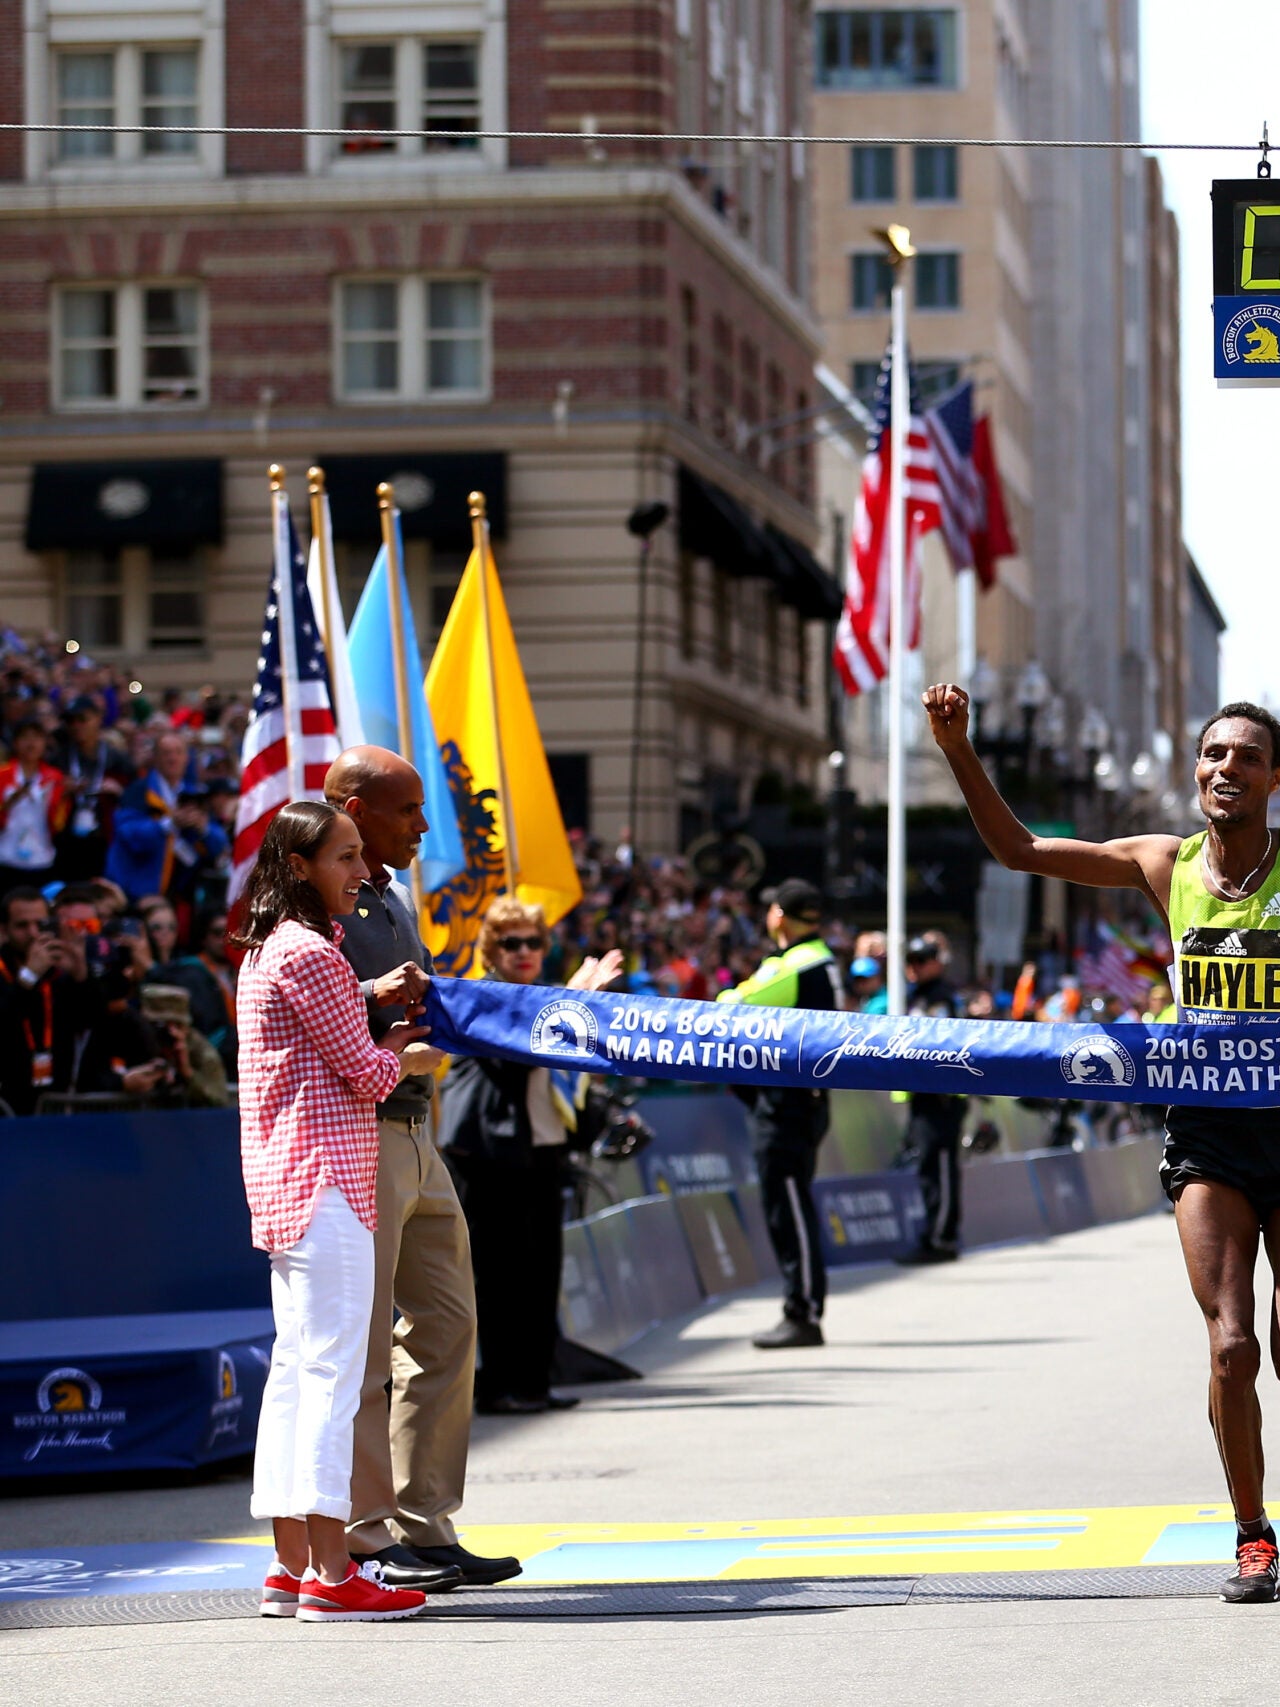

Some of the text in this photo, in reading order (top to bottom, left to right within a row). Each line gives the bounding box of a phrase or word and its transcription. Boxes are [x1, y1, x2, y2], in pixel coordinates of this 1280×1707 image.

[1225, 326, 1238, 359] BOSTON
[1233, 307, 1273, 328] ATHLETIC
[1214, 945, 1248, 956] adidas
[541, 1002, 577, 1019] ATHLETIC
[576, 1004, 597, 1054] ASSOCIATION
[609, 1006, 786, 1041] 2016 BOSTON
[1211, 1012, 1236, 1021] BOSTON
[605, 1035, 782, 1071] MARATHON
[1063, 1037, 1134, 1082] BOSTON ATHLETIC ASSOCIATION
[1145, 1037, 1208, 1060] 2016
[13, 1410, 127, 1428] BOSTON MARATHON
